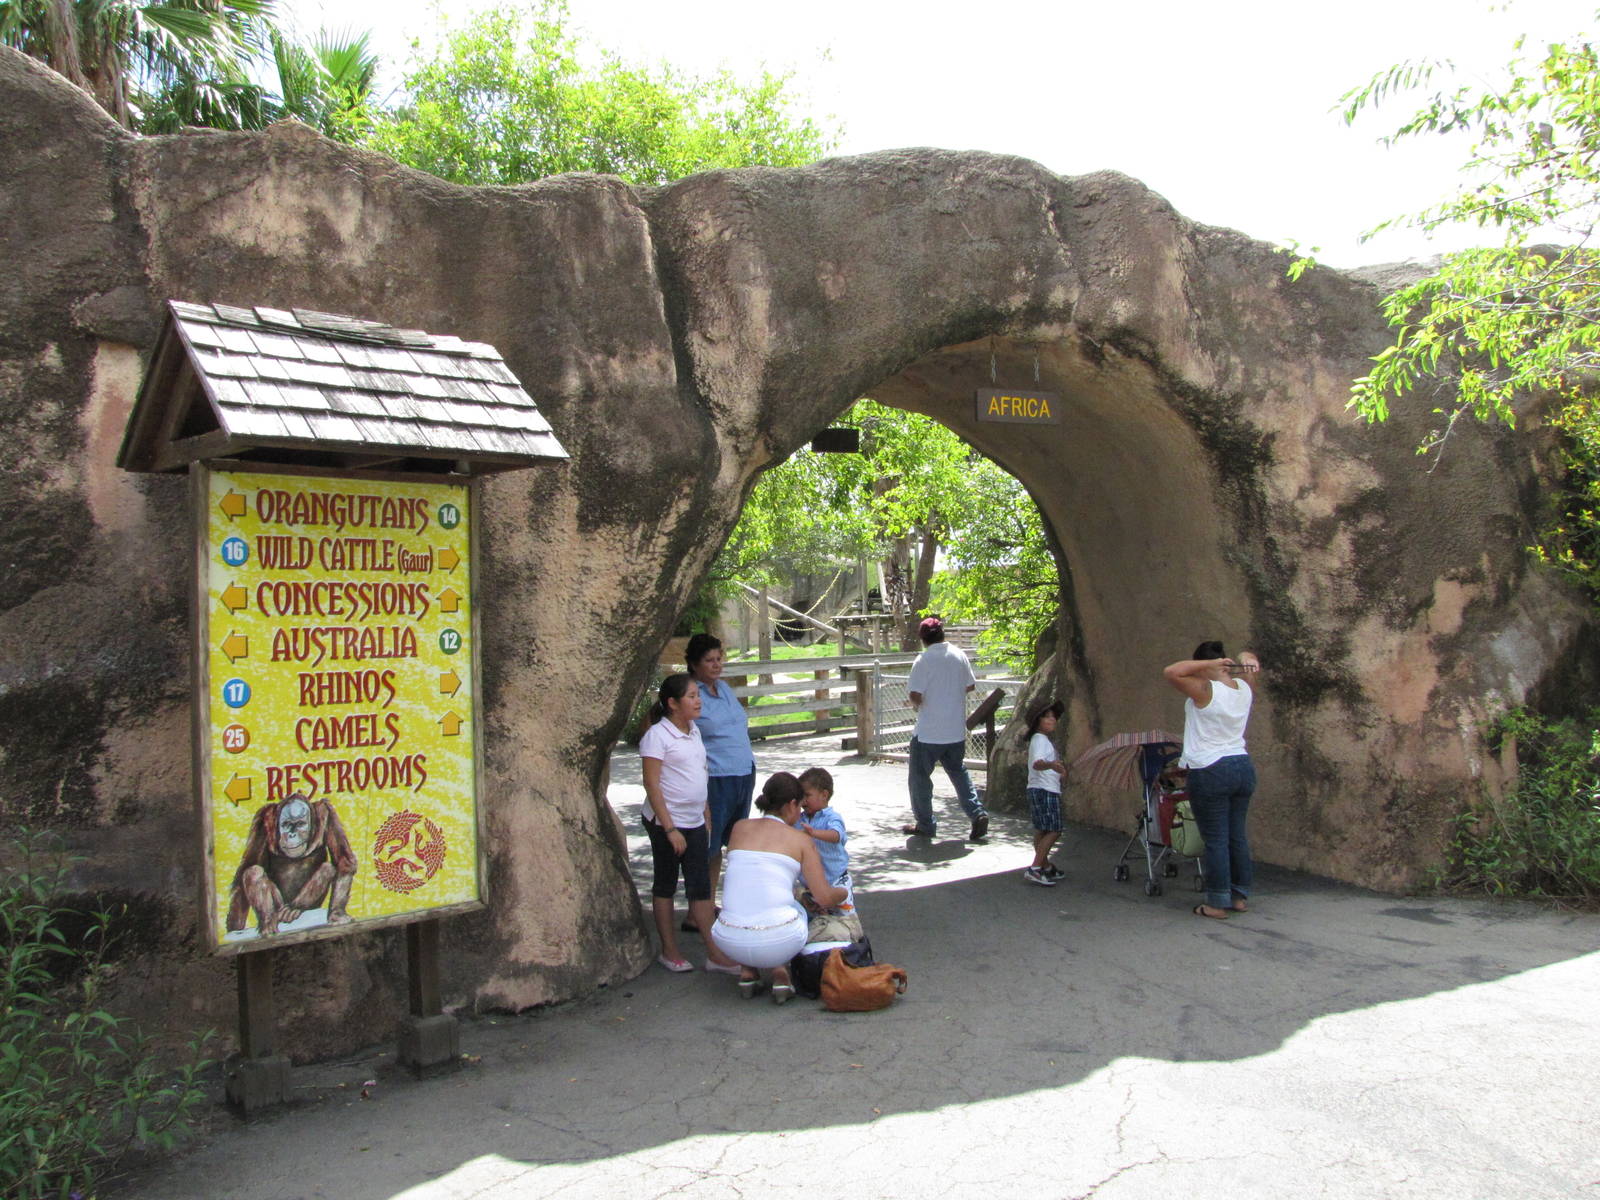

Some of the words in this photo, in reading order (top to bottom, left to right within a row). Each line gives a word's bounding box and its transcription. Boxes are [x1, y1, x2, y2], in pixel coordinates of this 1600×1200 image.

[988, 395, 1051, 418] AFRICA
[256, 489, 429, 536] ORANGUTANS
[441, 508, 457, 524] 14
[225, 541, 243, 560] 16
[256, 536, 314, 570] WILD
[319, 537, 395, 572] CATTLE
[397, 543, 433, 576] (Gaur)
[256, 581, 430, 622] CONCESSIONS
[271, 626, 418, 668] AUSTRALIA
[442, 633, 458, 649] 12
[228, 683, 244, 702] 17
[298, 669, 396, 709] RHINOS
[226, 729, 245, 748] 25
[295, 712, 400, 753] CAMELS
[265, 754, 427, 801] RESTROOMS
